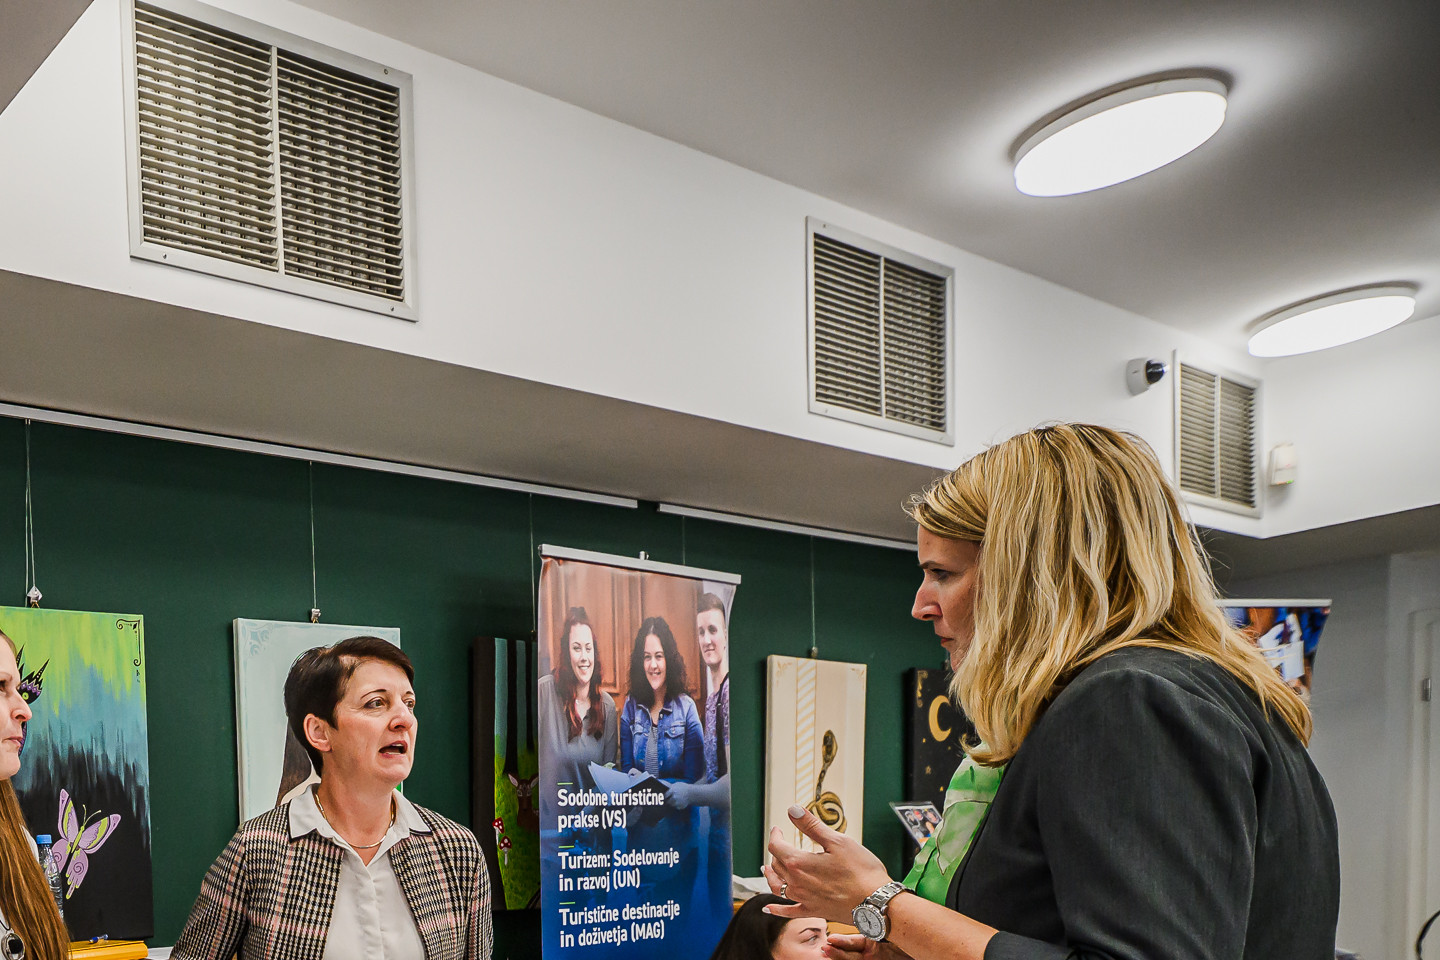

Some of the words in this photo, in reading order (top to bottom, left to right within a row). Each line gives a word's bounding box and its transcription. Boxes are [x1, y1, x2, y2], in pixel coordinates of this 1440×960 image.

[558, 789, 608, 806] Sodobne
[611, 789, 664, 805] turistične
[558, 811, 599, 832] prakse
[602, 808, 626, 829] (VS)
[558, 852, 610, 869] Turizem:
[613, 848, 679, 867] Sodelovanje
[559, 874, 573, 891] in
[578, 872, 610, 892] razvoj
[613, 868, 640, 889] (UN)
[559, 906, 618, 925] Turistične
[622, 900, 680, 920] destinacije
[560, 931, 574, 947] in
[578, 927, 627, 946] doživetja
[631, 920, 664, 942] (MAG)
